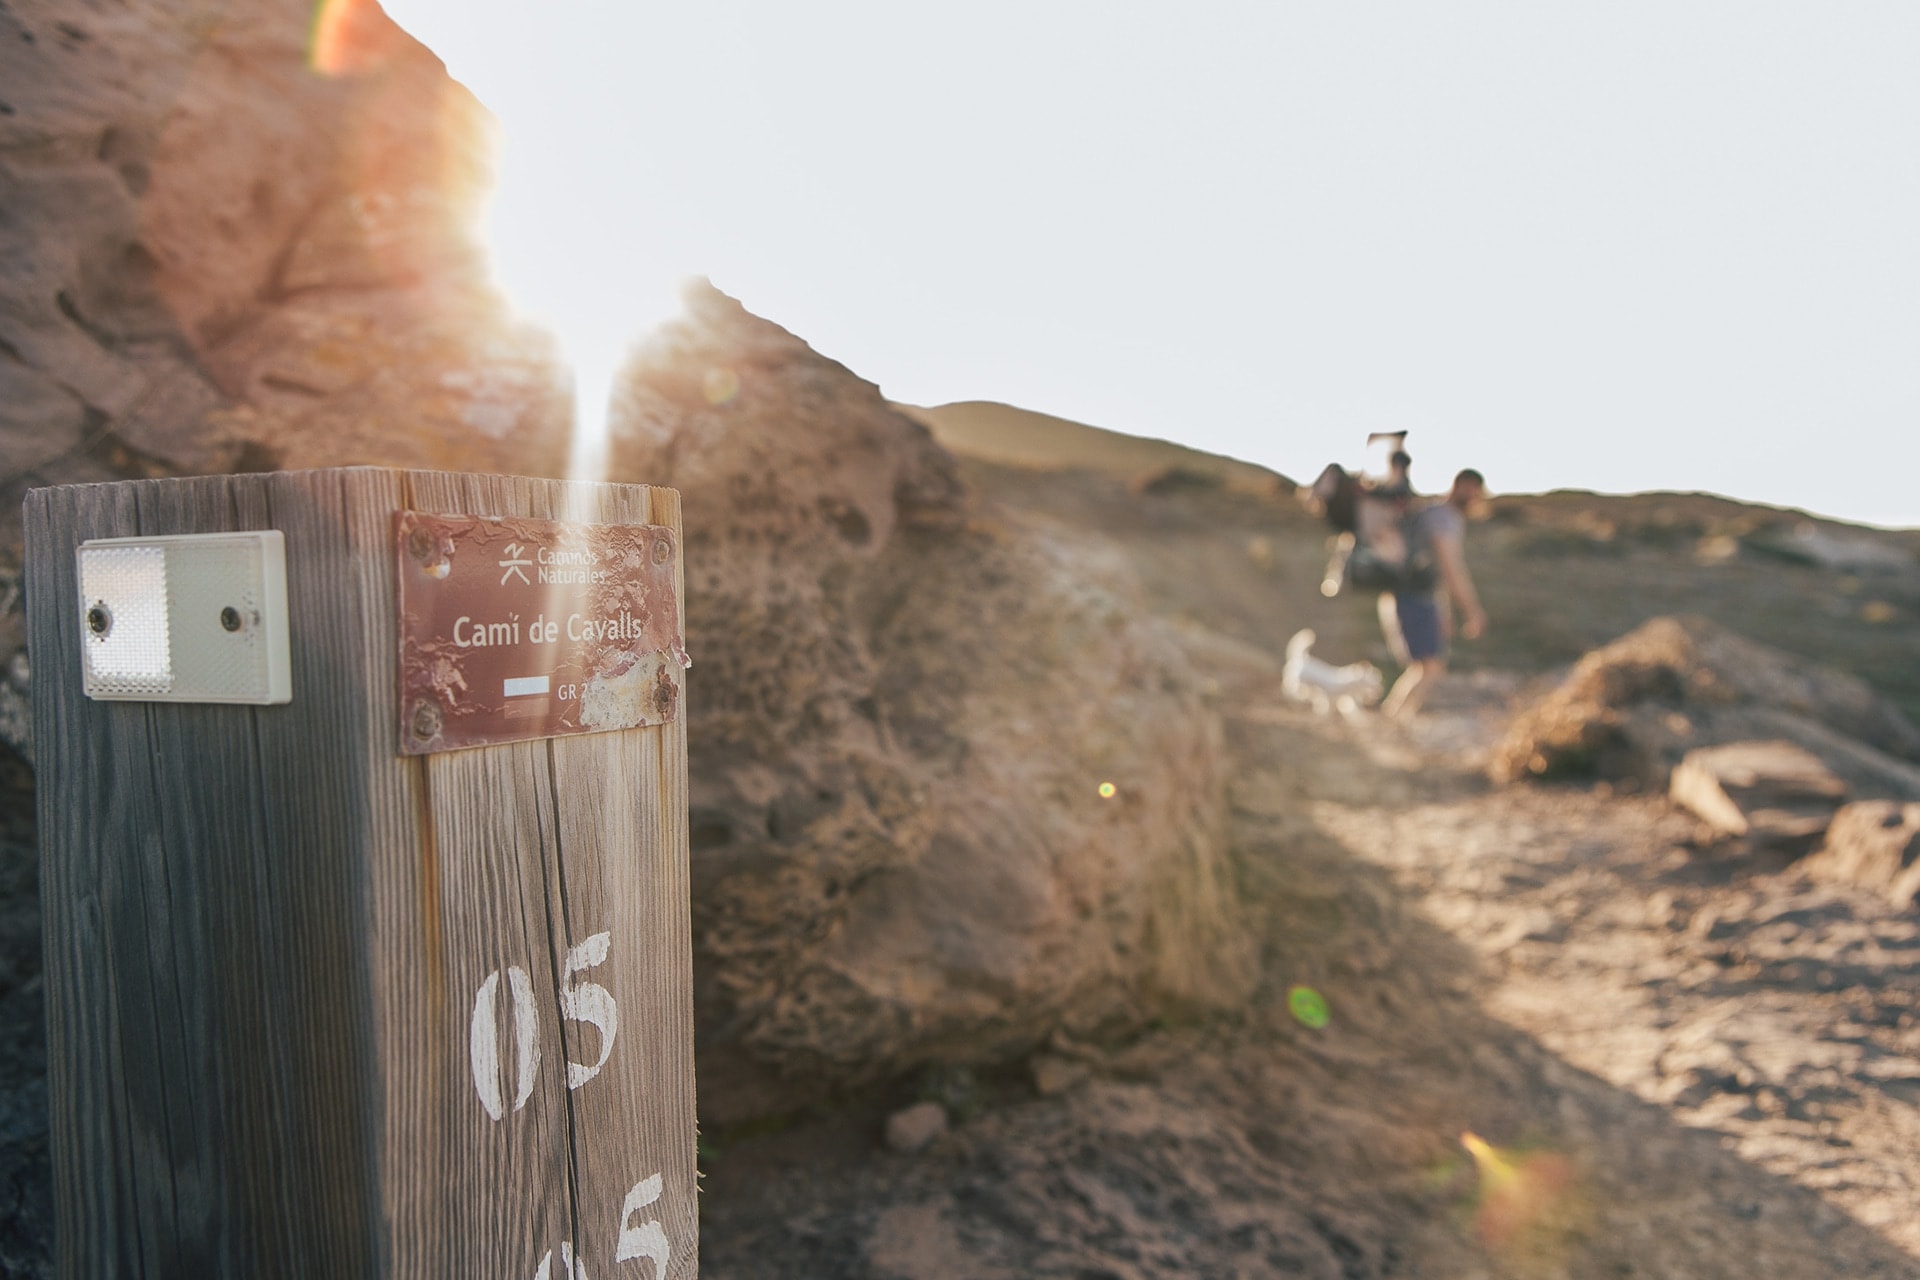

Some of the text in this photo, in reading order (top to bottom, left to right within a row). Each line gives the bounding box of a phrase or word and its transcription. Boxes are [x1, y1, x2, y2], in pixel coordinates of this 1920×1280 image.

[537, 547, 597, 565] Caminos
[537, 567, 606, 585] Naturales
[453, 611, 642, 648] Camí de Cavalls
[558, 684, 577, 701] GR
[470, 931, 617, 1121] 05
[535, 1172, 670, 1280] 5
